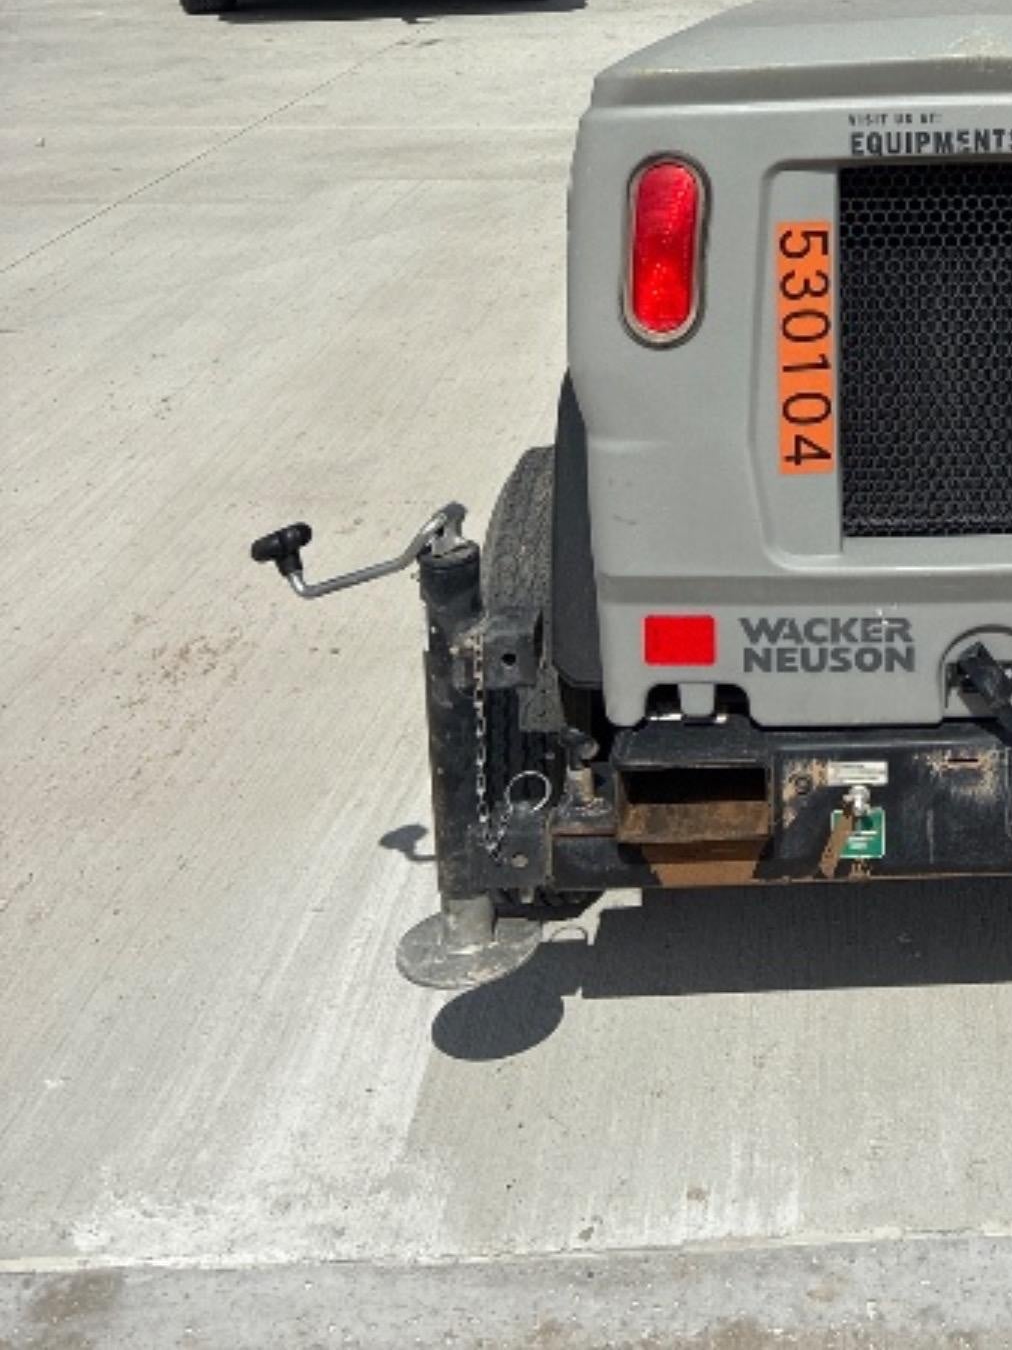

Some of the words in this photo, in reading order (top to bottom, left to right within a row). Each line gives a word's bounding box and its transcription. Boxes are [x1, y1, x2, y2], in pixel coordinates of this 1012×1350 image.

[779, 229, 832, 466] 530104
[738, 617, 914, 644] WACKER
[743, 647, 915, 673] NEUSON
